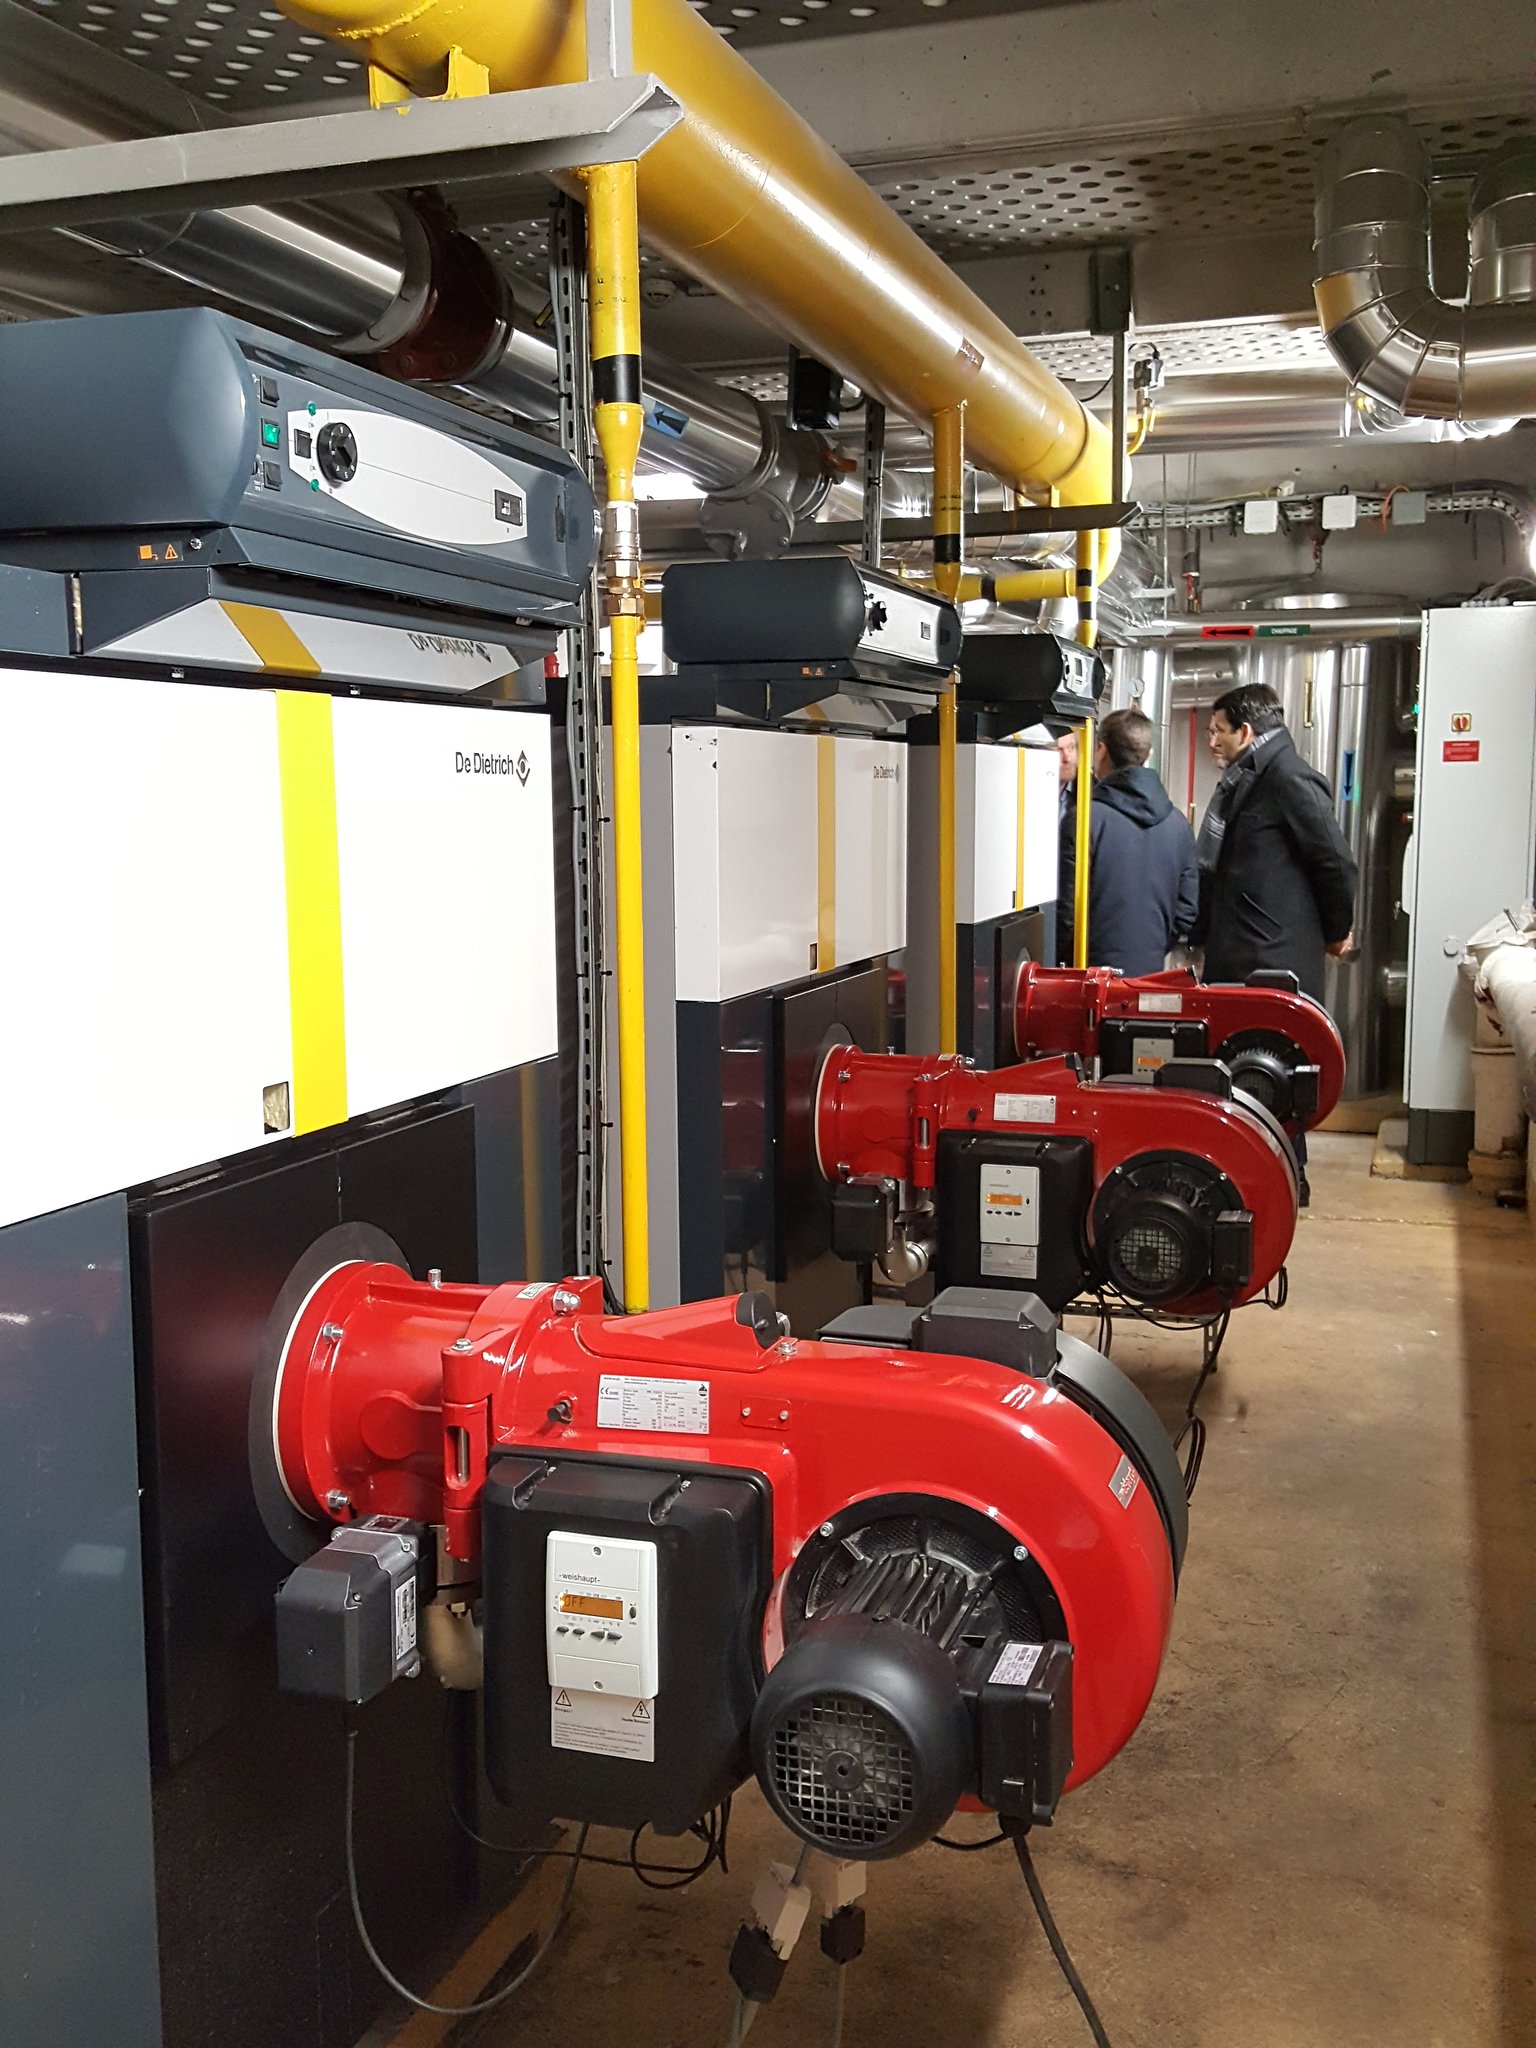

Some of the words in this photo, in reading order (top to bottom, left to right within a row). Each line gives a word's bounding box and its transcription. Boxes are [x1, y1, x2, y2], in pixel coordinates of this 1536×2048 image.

[456, 751, 471, 773] De
[473, 752, 514, 775] Dietrich
[564, 1595, 585, 1608] OFF
